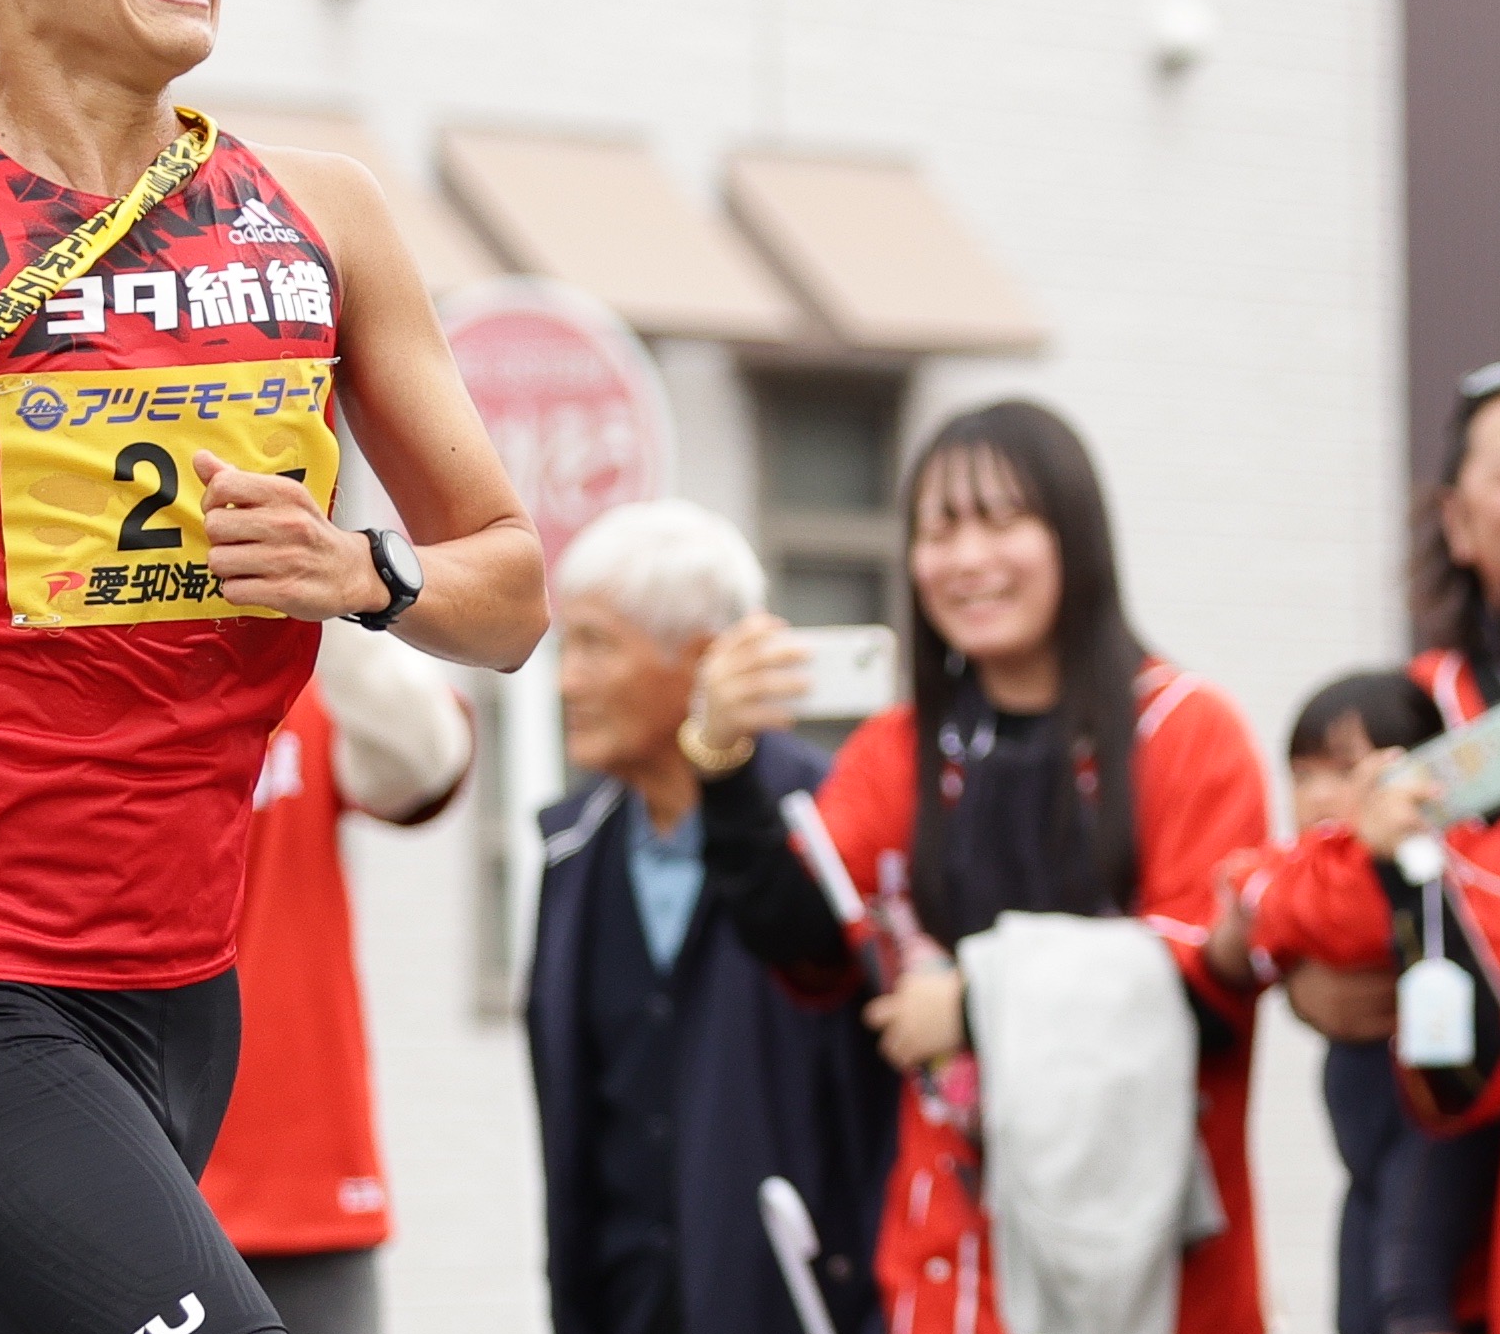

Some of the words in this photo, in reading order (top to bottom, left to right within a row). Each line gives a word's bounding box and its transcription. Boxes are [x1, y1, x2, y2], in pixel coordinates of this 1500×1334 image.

[228, 223, 300, 245] adidas
[84, 561, 226, 605] 愛知海
